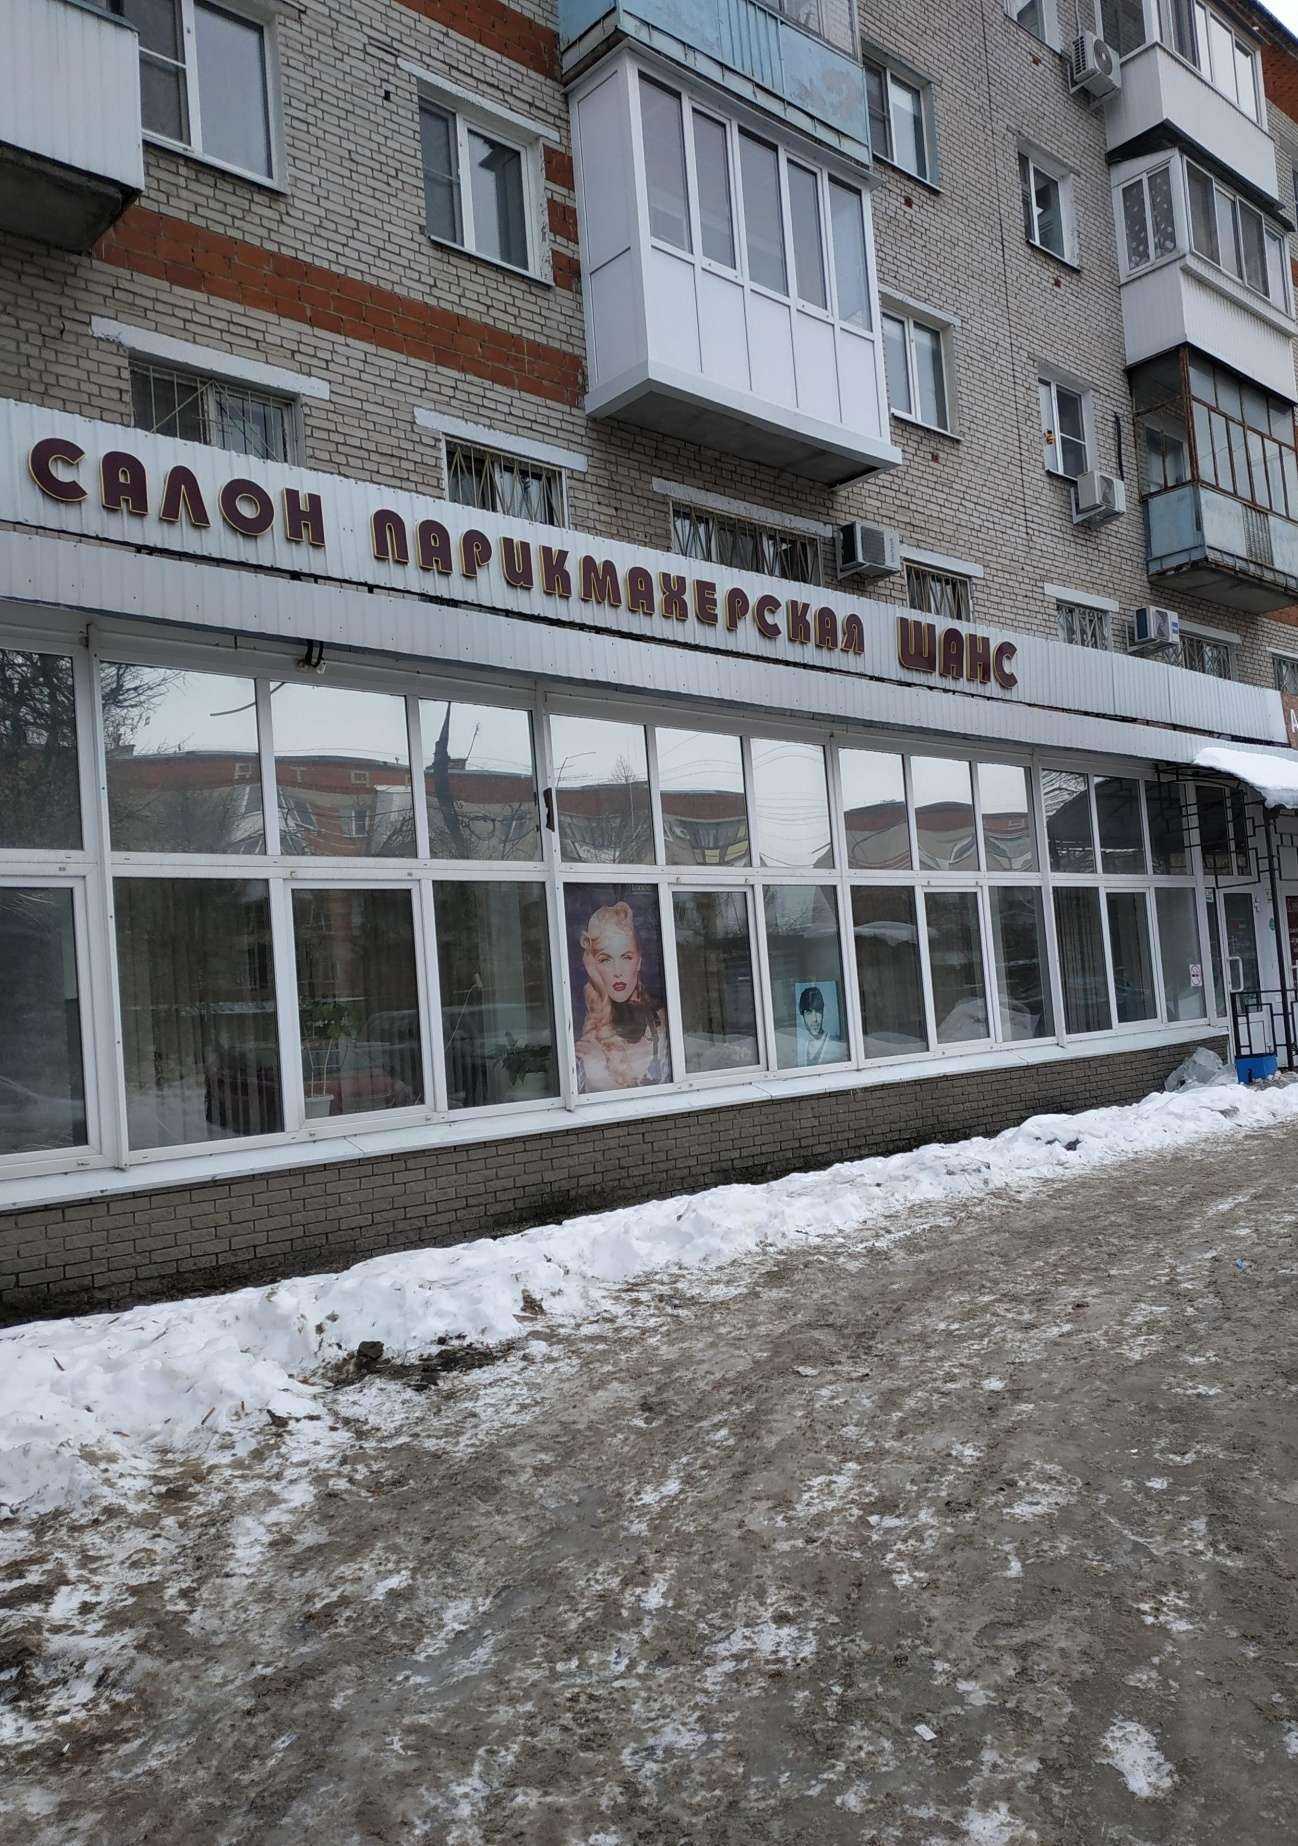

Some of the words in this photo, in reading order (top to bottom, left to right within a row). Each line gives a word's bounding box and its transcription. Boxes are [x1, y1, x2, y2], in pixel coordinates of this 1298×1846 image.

[28, 437, 325, 547] САЛОН
[371, 508, 865, 655] ПАРИКМАХЕРСКАЯ
[898, 615, 1019, 690] ШАНС
